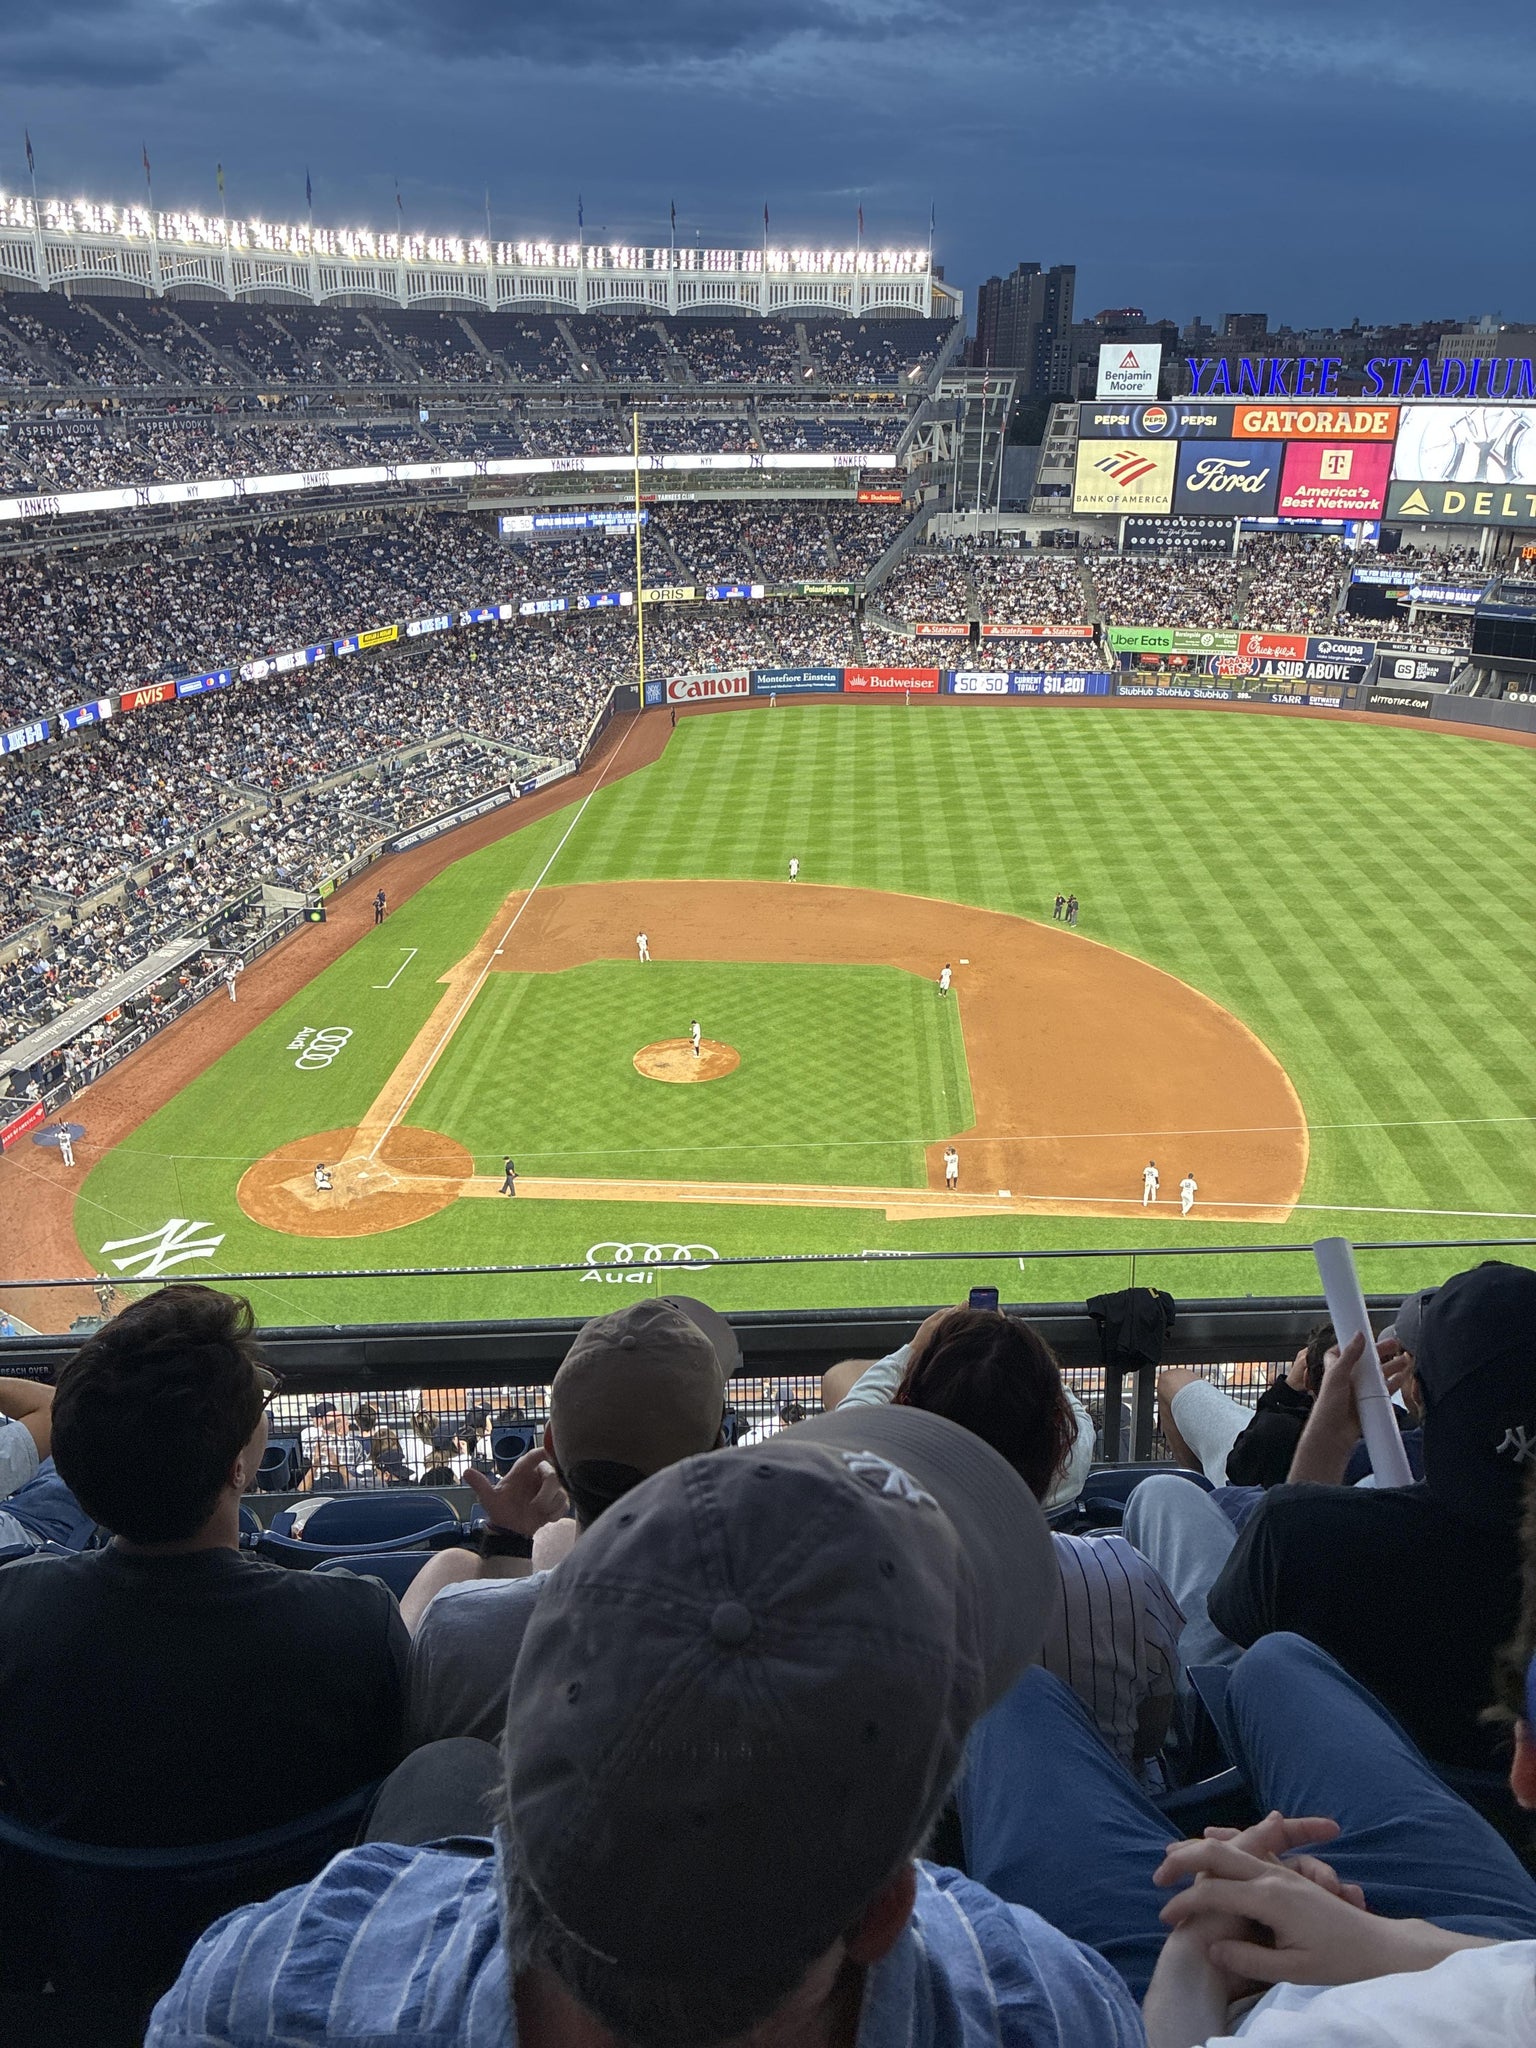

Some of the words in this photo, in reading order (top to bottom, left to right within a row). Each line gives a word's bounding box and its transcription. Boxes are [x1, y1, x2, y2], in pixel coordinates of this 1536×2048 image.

[1105, 371, 1152, 382] Benjamin
[1185, 358, 1342, 397] YANKEE
[1110, 382, 1143, 391] Moore
[179, 420, 208, 430] VODKA
[1094, 415, 1130, 426] PEPSI
[1180, 415, 1218, 427] PEPSI
[1243, 410, 1391, 435] GATORADE
[18, 426, 53, 437] ASPEN
[65, 424, 99, 435] VODKA
[551, 458, 585, 471] YANKEES
[700, 456, 712, 466] NYY
[833, 455, 868, 467] YANKEES
[430, 465, 442, 476] NYY
[1186, 457, 1270, 494] Ford
[301, 472, 330, 487] YANKEES
[187, 485, 199, 497] NYY
[658, 493, 681, 501] YANKEES
[1077, 495, 1104, 503] BANK
[1107, 495, 1119, 503] OF
[1122, 496, 1169, 504] AMERICA
[1282, 498, 1317, 508] Best
[1319, 498, 1380, 511] Network
[17, 497, 60, 518] YANKEES
[650, 589, 684, 601] ORIS
[804, 584, 827, 594] Poland
[828, 585, 850, 596] Spring
[1111, 633, 1139, 645] Uber
[1140, 635, 1170, 646] Eats
[1332, 644, 1363, 656] coupa
[1216, 655, 1253, 666] Jersey
[1264, 661, 1275, 676] A
[1276, 662, 1304, 678] SUB
[1306, 662, 1350, 681] ABOVE
[1398, 664, 1412, 675] GS
[757, 673, 801, 684] Montefiore
[803, 672, 836, 681] Einstein
[1014, 676, 1043, 684] CURRENT
[668, 675, 748, 699] Canon
[960, 677, 977, 691] 50
[985, 678, 1003, 692] 50
[1043, 675, 1086, 694] $11,201
[134, 686, 164, 707] AVIS
[1119, 685, 1154, 696] StubHub
[1156, 686, 1191, 698] StubHub
[1193, 688, 1229, 699] StubHub
[1271, 694, 1302, 704] STARR
[1309, 696, 1341, 705] CUTWATER
[1370, 694, 1429, 710] NITTOTIRE.COM
[286, 1026, 317, 1050] Audi
[579, 1269, 654, 1284] Audi
[0, 1367, 27, 1375] REACH
